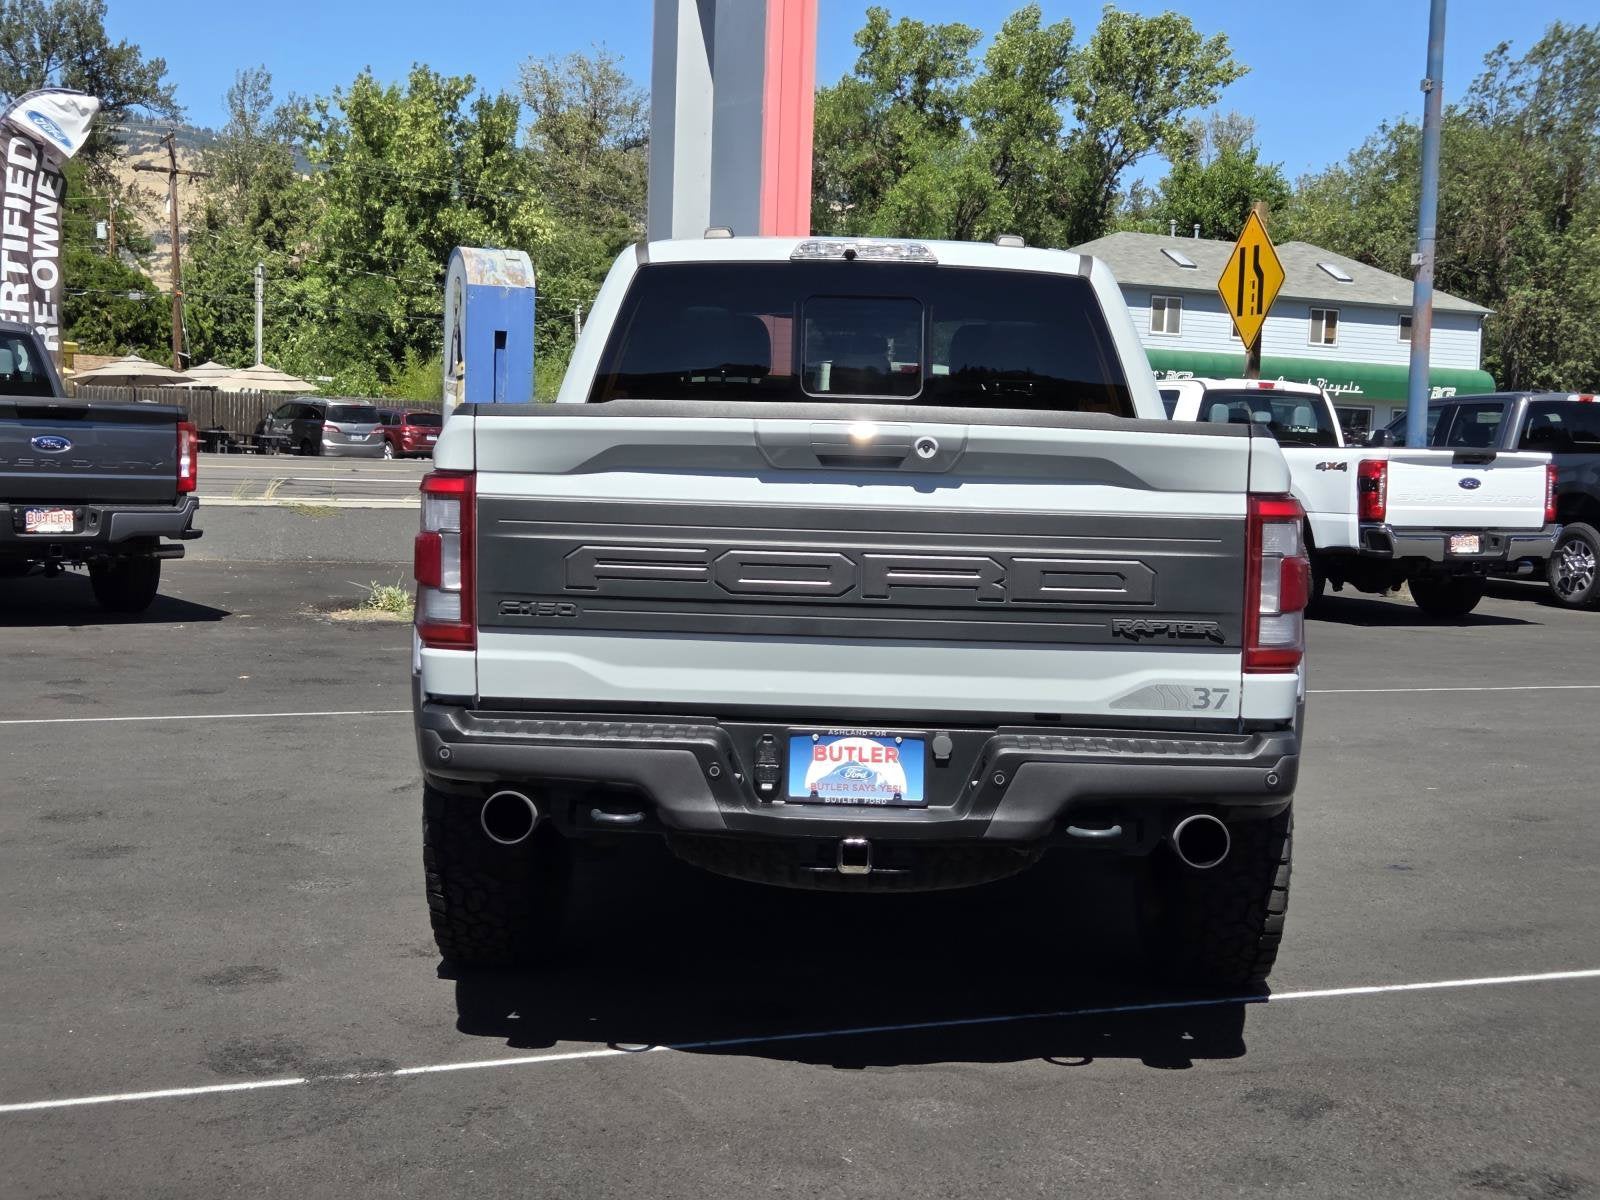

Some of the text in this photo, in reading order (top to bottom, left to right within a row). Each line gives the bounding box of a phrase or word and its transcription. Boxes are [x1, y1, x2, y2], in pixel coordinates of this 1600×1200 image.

[27, 512, 73, 523] BUTLER
[563, 545, 1157, 606] FORD
[498, 600, 578, 617] F-150
[1111, 618, 1225, 644] RAPTOR
[1192, 687, 1230, 710] 37
[813, 745, 899, 763] BUTLER
[843, 767, 870, 779] Ford
[810, 782, 903, 794] BUTLER SAYS YES!
[864, 797, 888, 805] FORD
